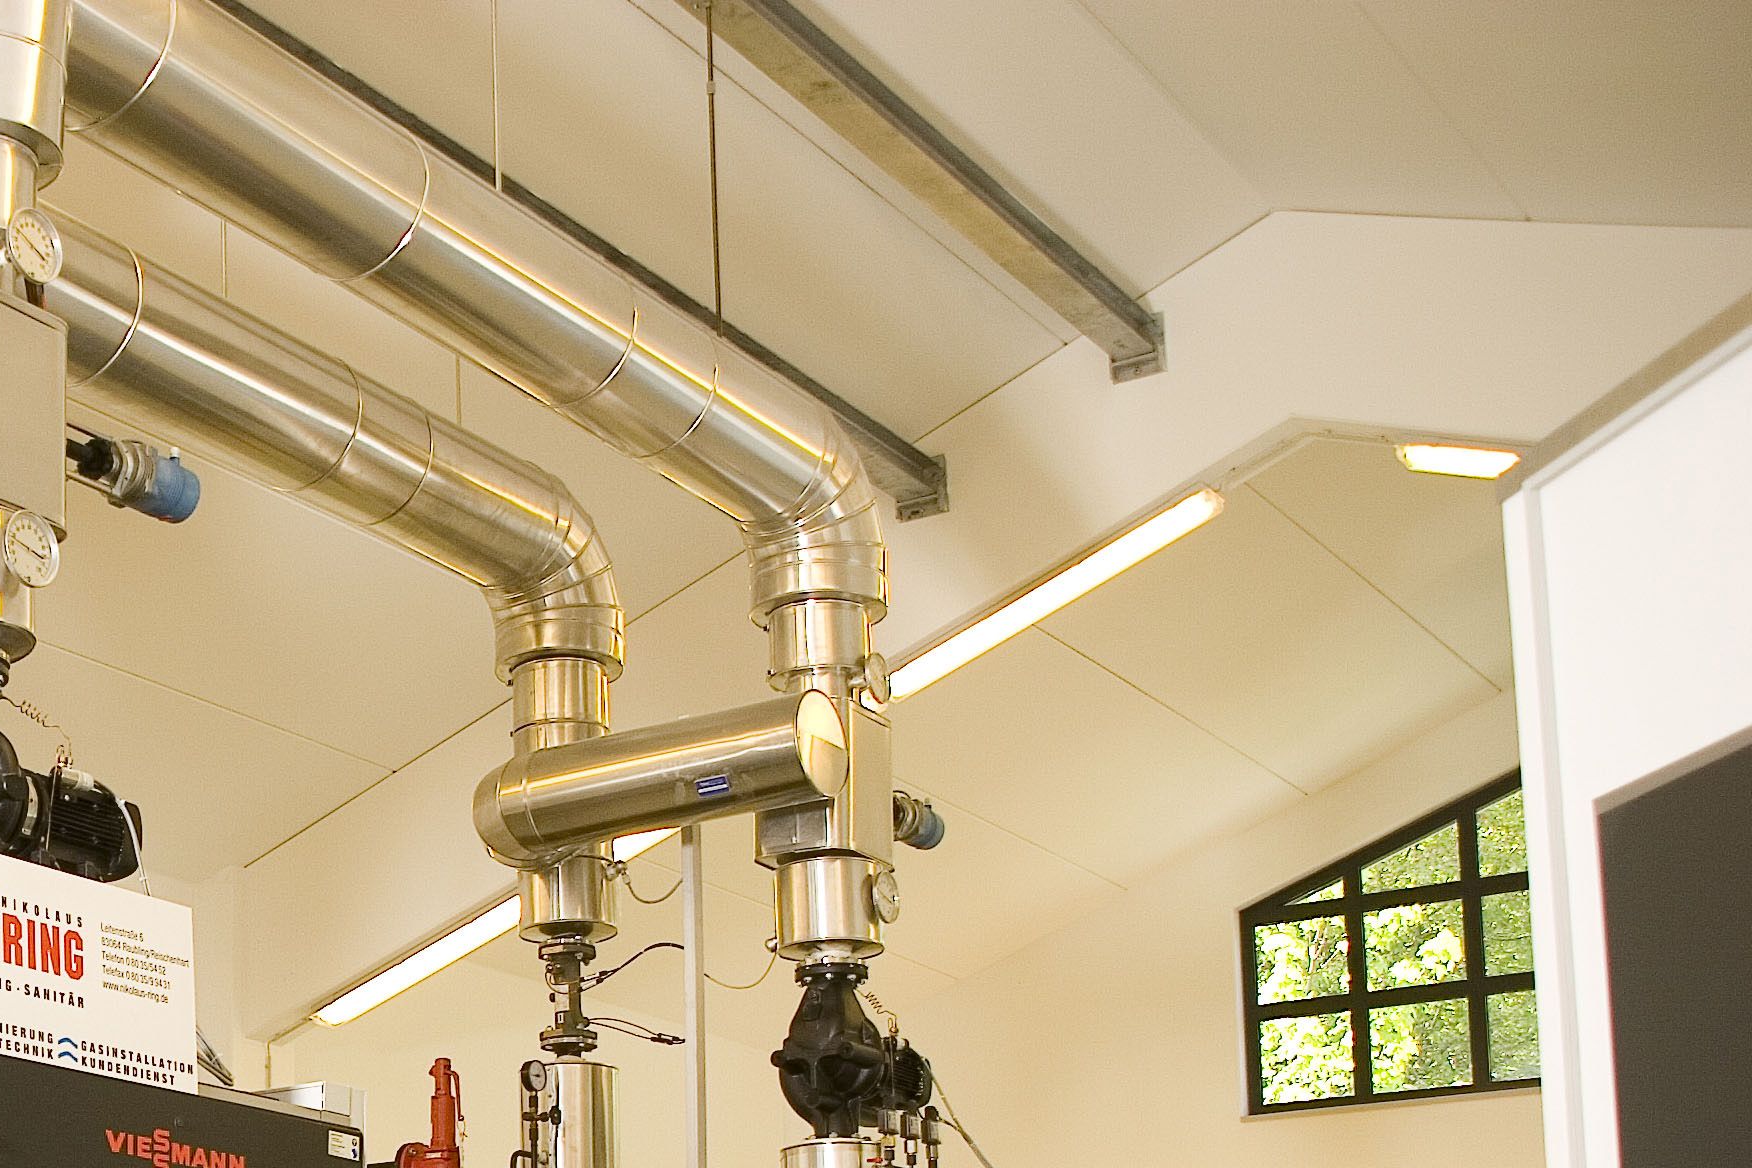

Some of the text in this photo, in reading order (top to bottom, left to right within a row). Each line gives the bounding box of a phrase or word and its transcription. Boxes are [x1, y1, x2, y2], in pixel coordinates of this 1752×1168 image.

[1, 895, 84, 928] NIKOLAUS
[2, 912, 84, 981] RING
[23, 983, 85, 1009] SANITÄR
[80, 1040, 194, 1075] GASINSTALLATION
[81, 1055, 175, 1086] KUNDENDIENST
